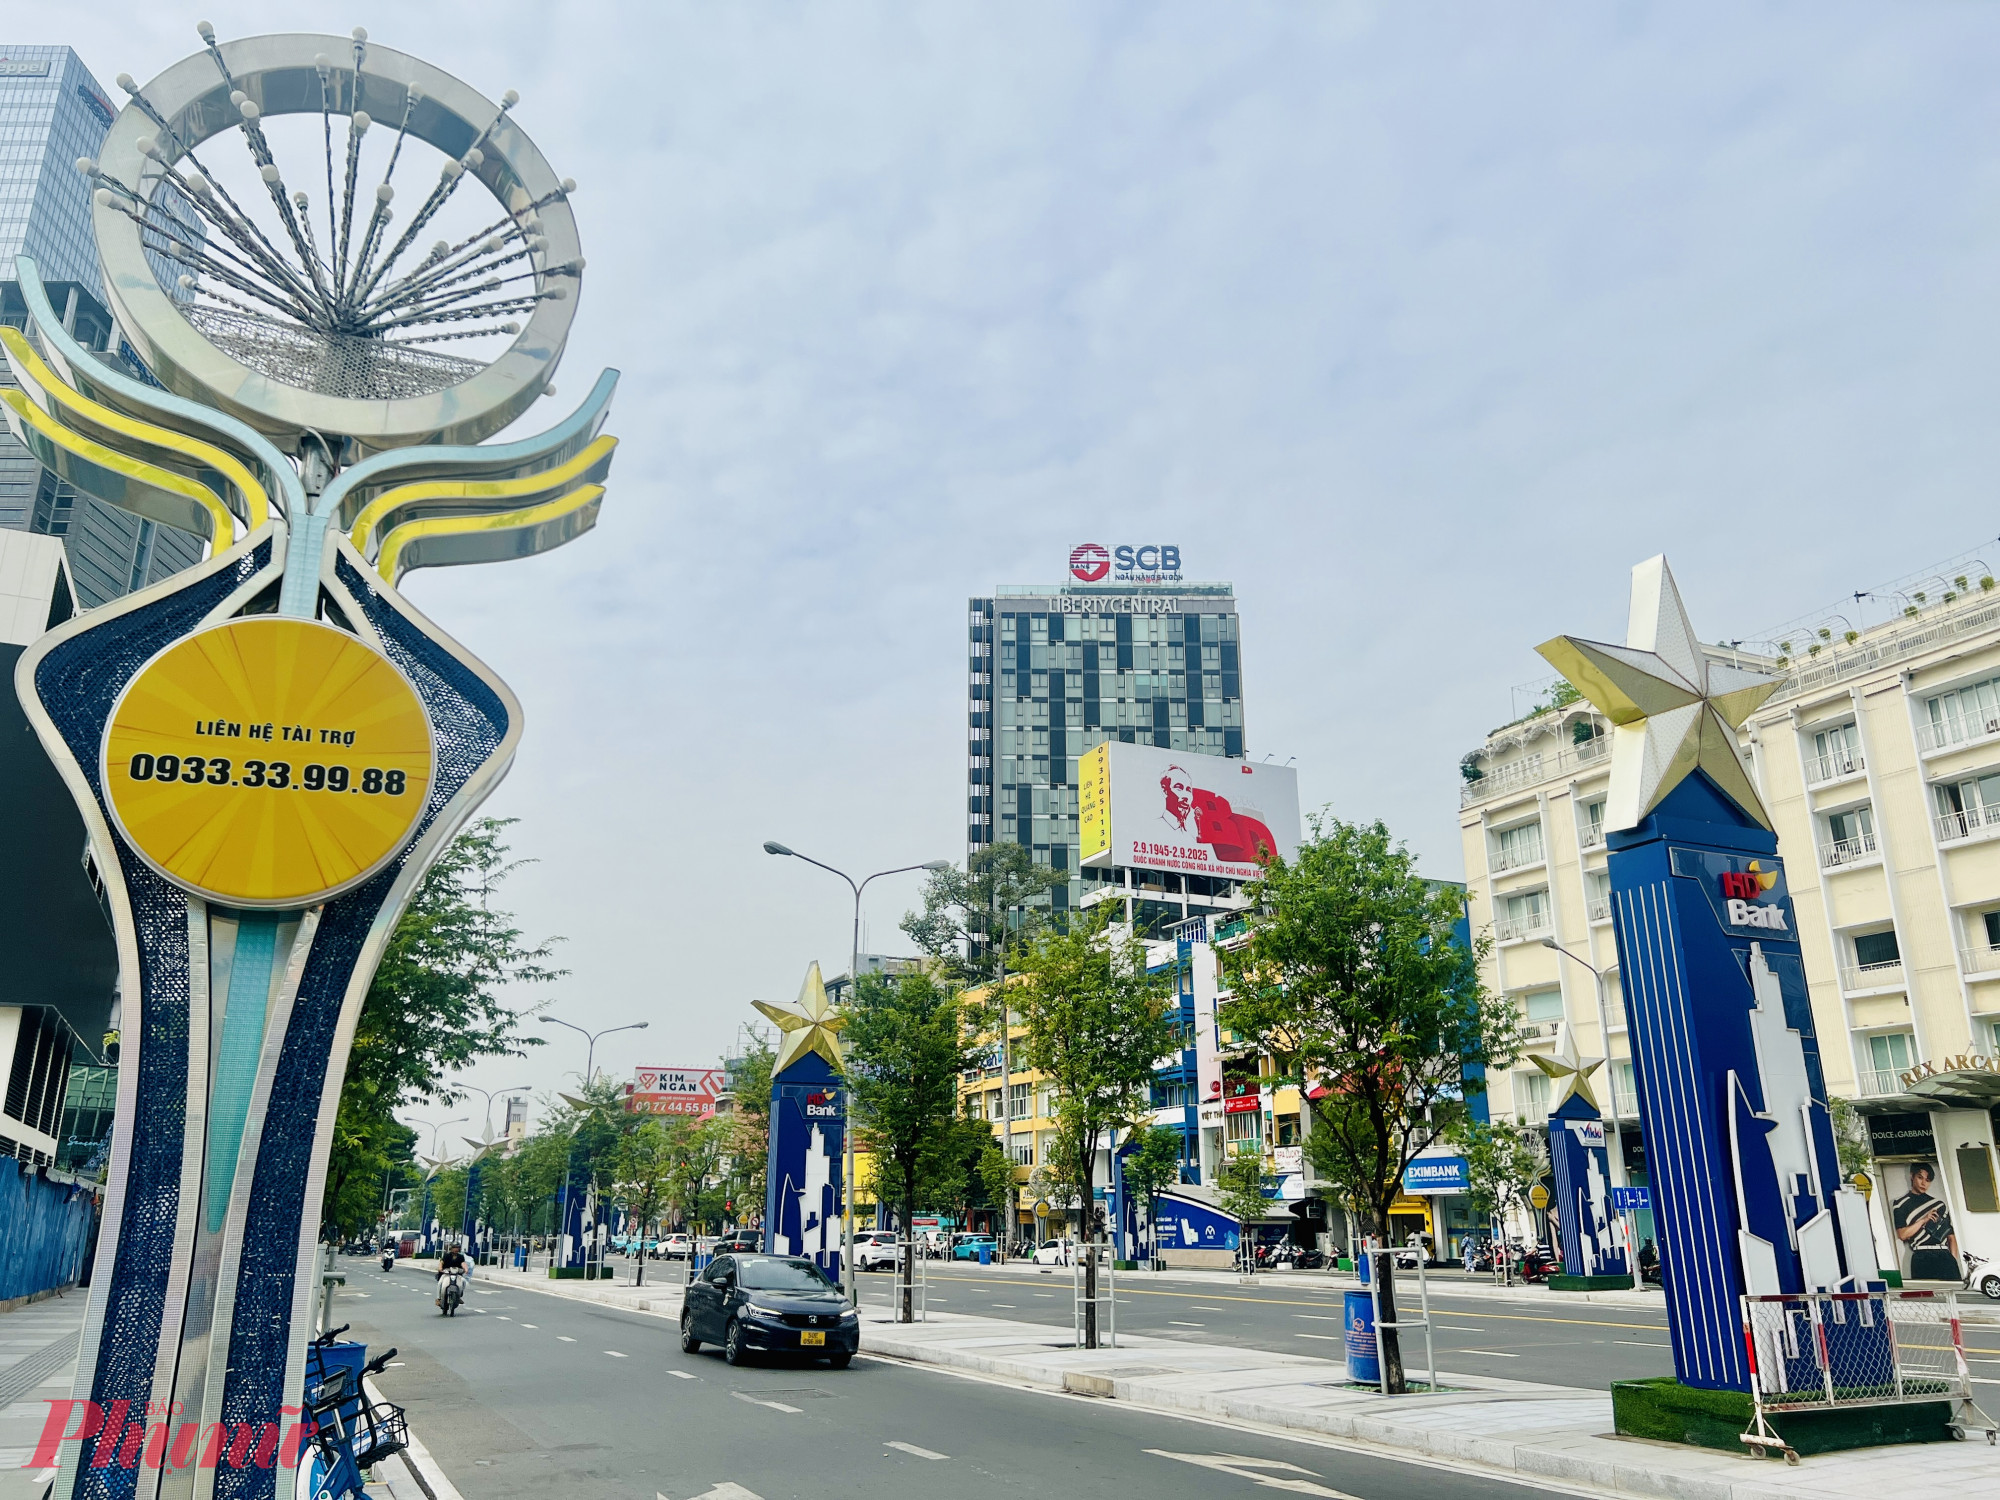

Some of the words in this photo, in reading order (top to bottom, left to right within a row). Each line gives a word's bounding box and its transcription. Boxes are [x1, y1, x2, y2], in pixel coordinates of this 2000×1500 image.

[0, 61, 44, 73] eppel
[1115, 545, 1181, 571] SCB
[1049, 598, 1109, 613] LIBERTY
[1110, 598, 1181, 613] CENTRAL
[195, 719, 241, 738] LIÊN
[249, 722, 273, 742] HỆ
[281, 725, 311, 742] TÀI
[319, 729, 356, 748] TRỢ
[130, 753, 406, 796] 0933.33.99.88
[1133, 841, 1208, 861] 2.9.1945-2.9.2025
[1723, 871, 1760, 899] HD
[1728, 899, 1788, 930] Bank
[659, 1073, 684, 1083] KIM
[1899, 1060, 1938, 1089] REX
[1944, 1055, 2000, 1074] ARCA
[659, 1082, 697, 1092] NGAN
[807, 1093, 825, 1105] HD
[684, 1102, 699, 1112] 55
[807, 1104, 836, 1116] Bank
[1580, 1121, 1602, 1139] Vikki
[1872, 1131, 1895, 1140] DOLCE
[1898, 1129, 1934, 1139] GABBANA
[1408, 1164, 1460, 1178] EXIMBANK
